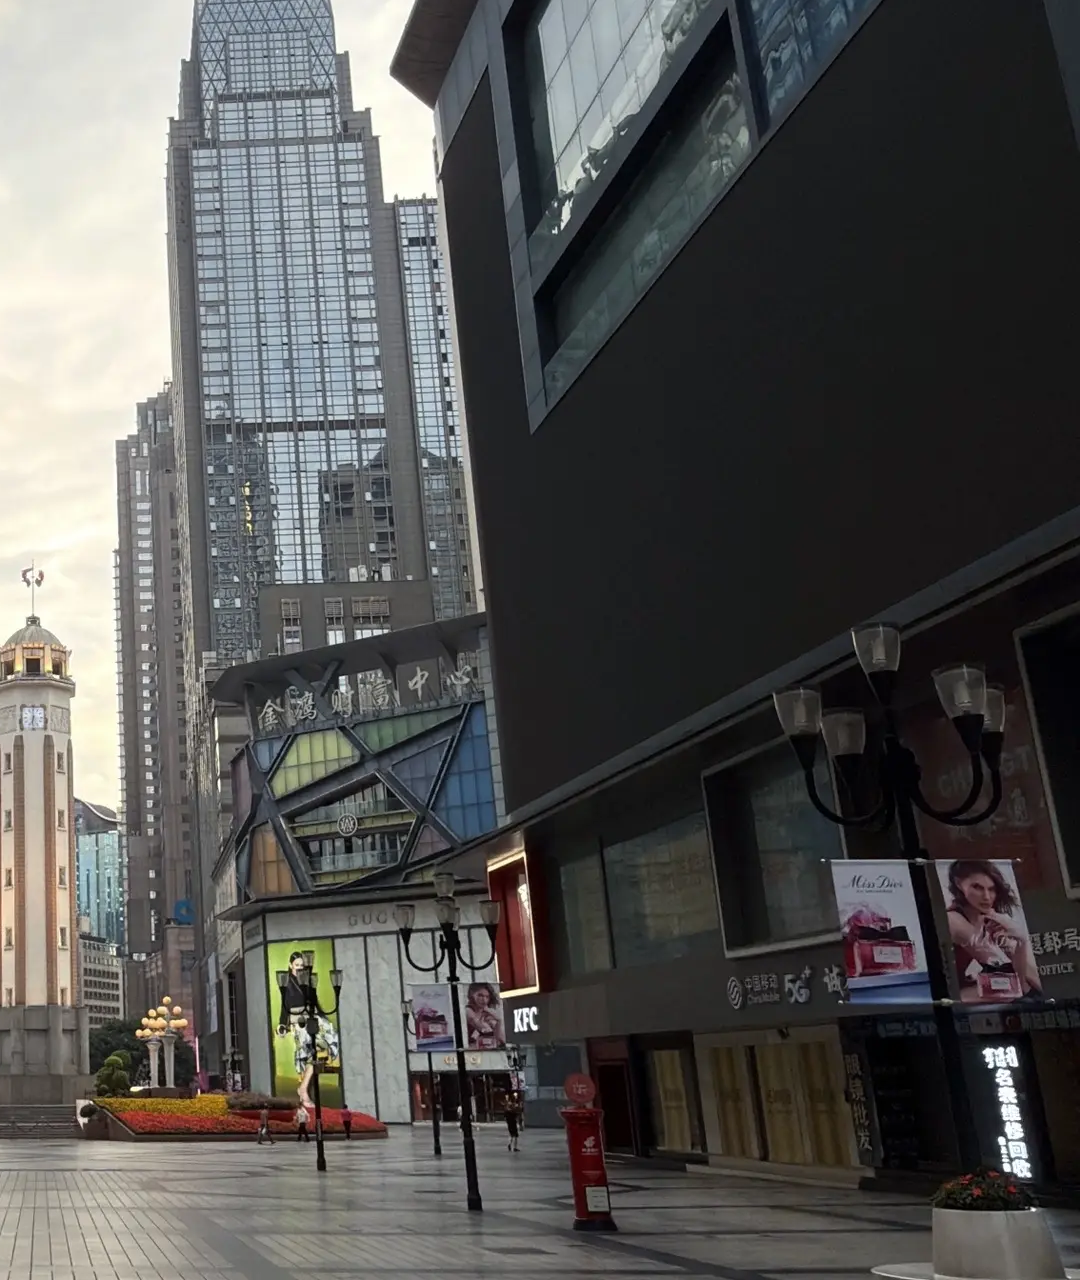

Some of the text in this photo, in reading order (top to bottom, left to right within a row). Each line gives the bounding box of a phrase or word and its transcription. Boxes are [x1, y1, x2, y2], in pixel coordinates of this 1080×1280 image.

[259, 664, 472, 729] 金鹰财富中心
[513, 1006, 539, 1032] KFC
